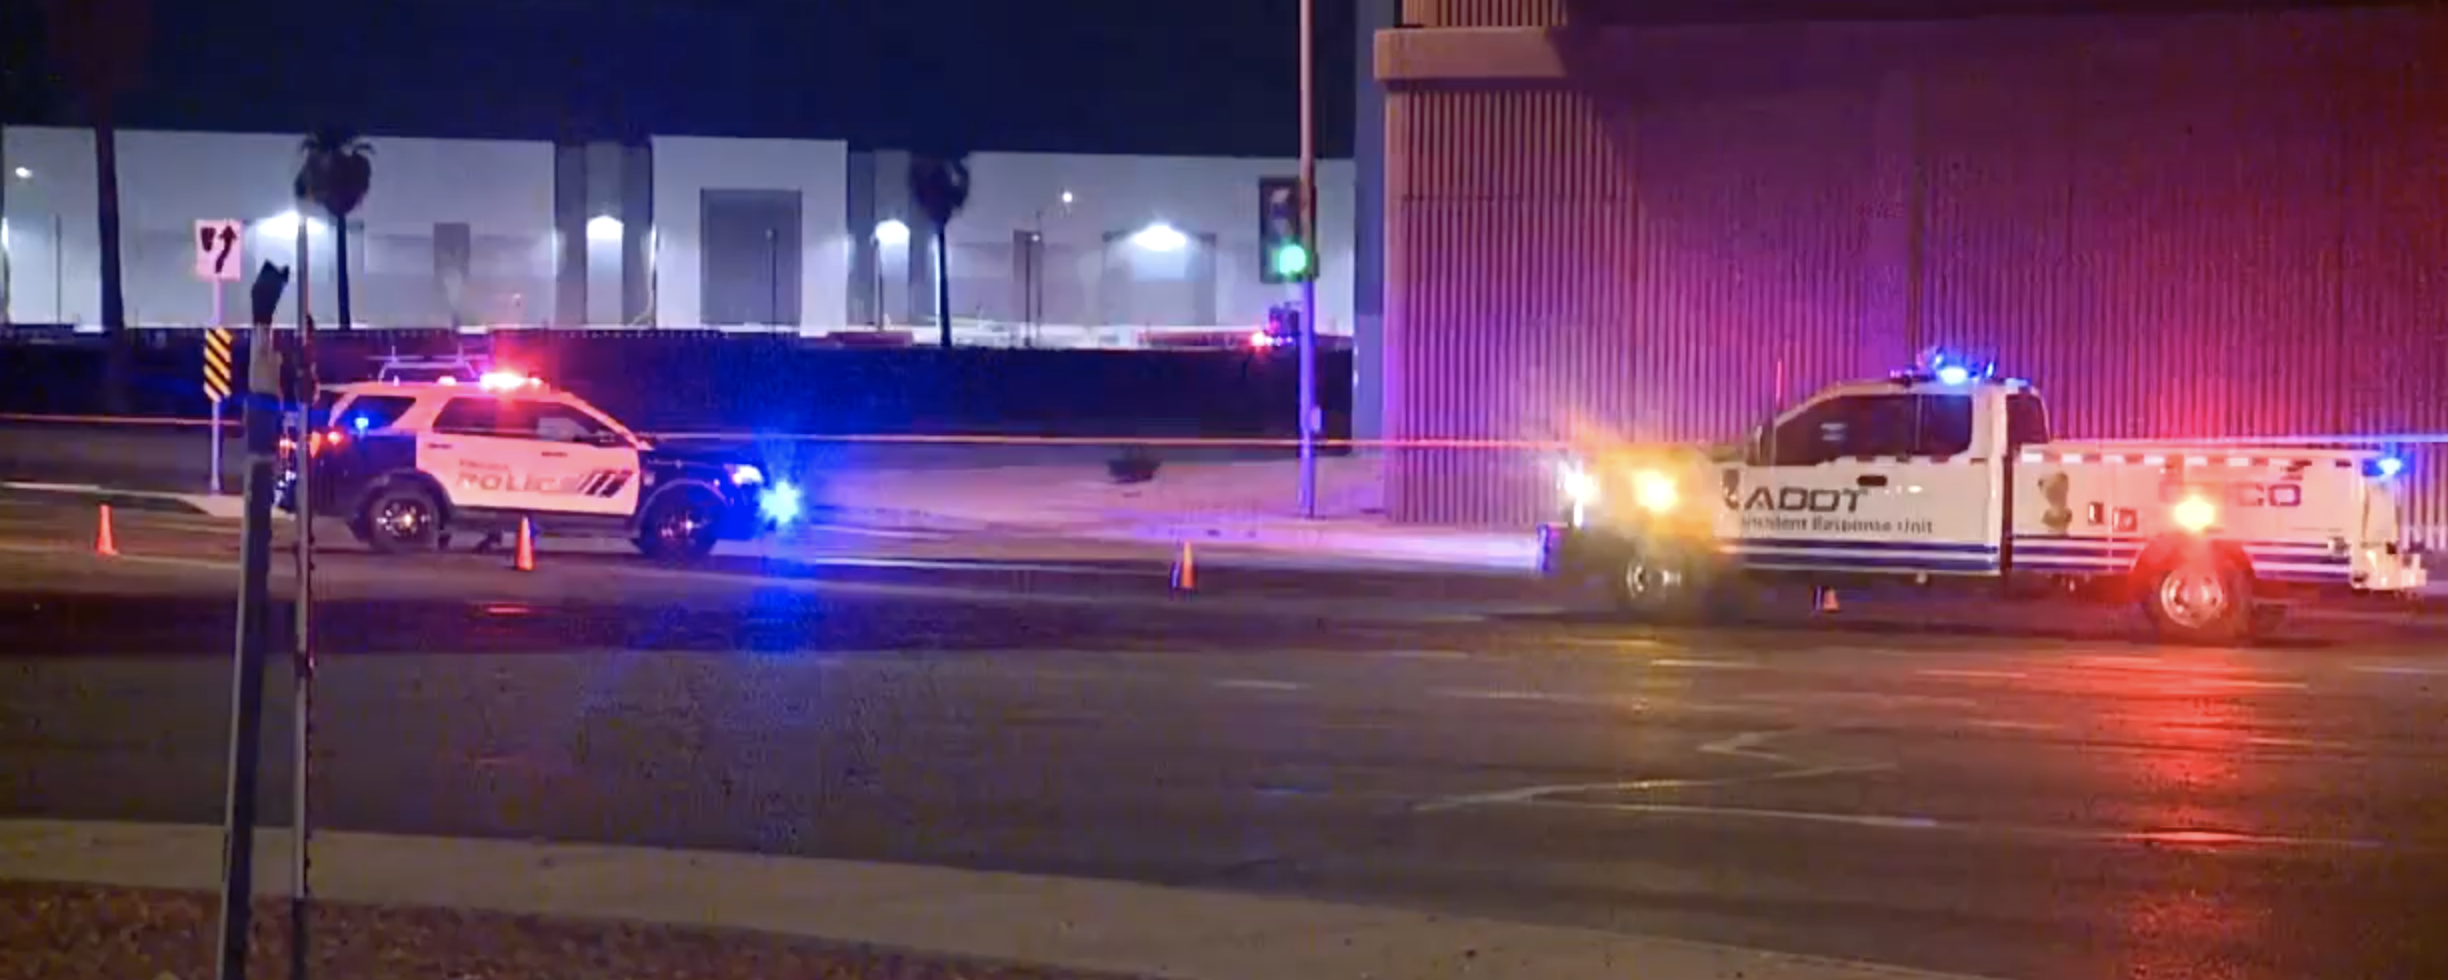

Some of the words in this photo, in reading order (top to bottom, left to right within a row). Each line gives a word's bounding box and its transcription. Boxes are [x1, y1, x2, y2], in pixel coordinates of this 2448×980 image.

[458, 472, 580, 493] POLIC
[1744, 487, 1869, 512] ADOT
[1896, 518, 1933, 534] Unit
